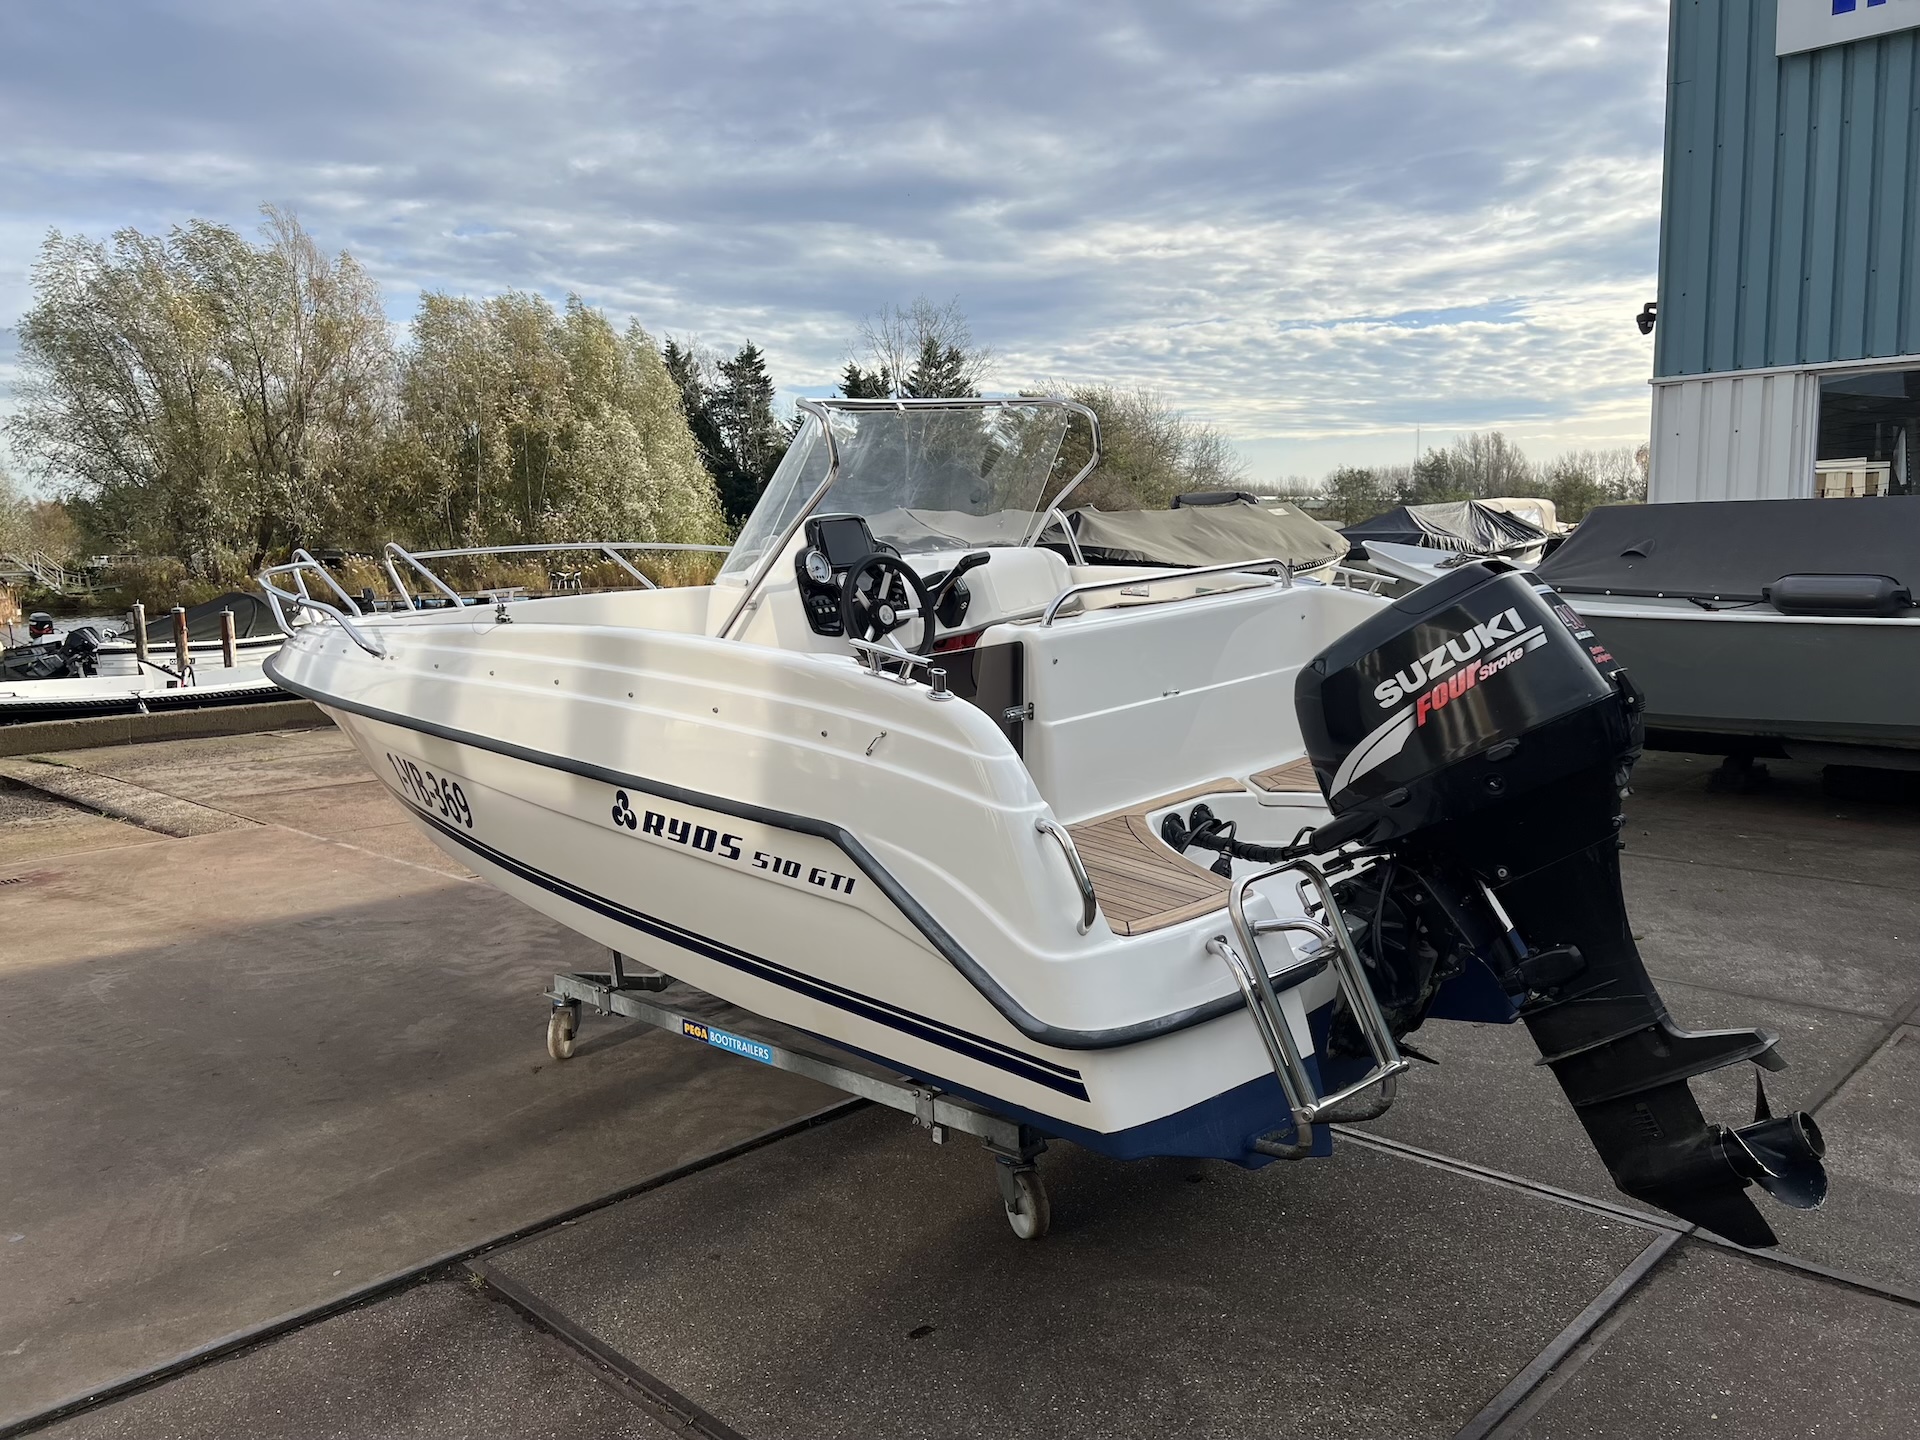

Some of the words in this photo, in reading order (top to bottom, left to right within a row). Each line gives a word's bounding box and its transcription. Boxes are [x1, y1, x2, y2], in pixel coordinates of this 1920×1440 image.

[1373, 607, 1527, 709] SUZUKI
[386, 752, 473, 829] 1-YB-369
[751, 851, 802, 879] 510
[807, 867, 856, 895] GTI
[684, 1022, 708, 1040] PEGA
[709, 1031, 770, 1060] BOOTTRAILERS
